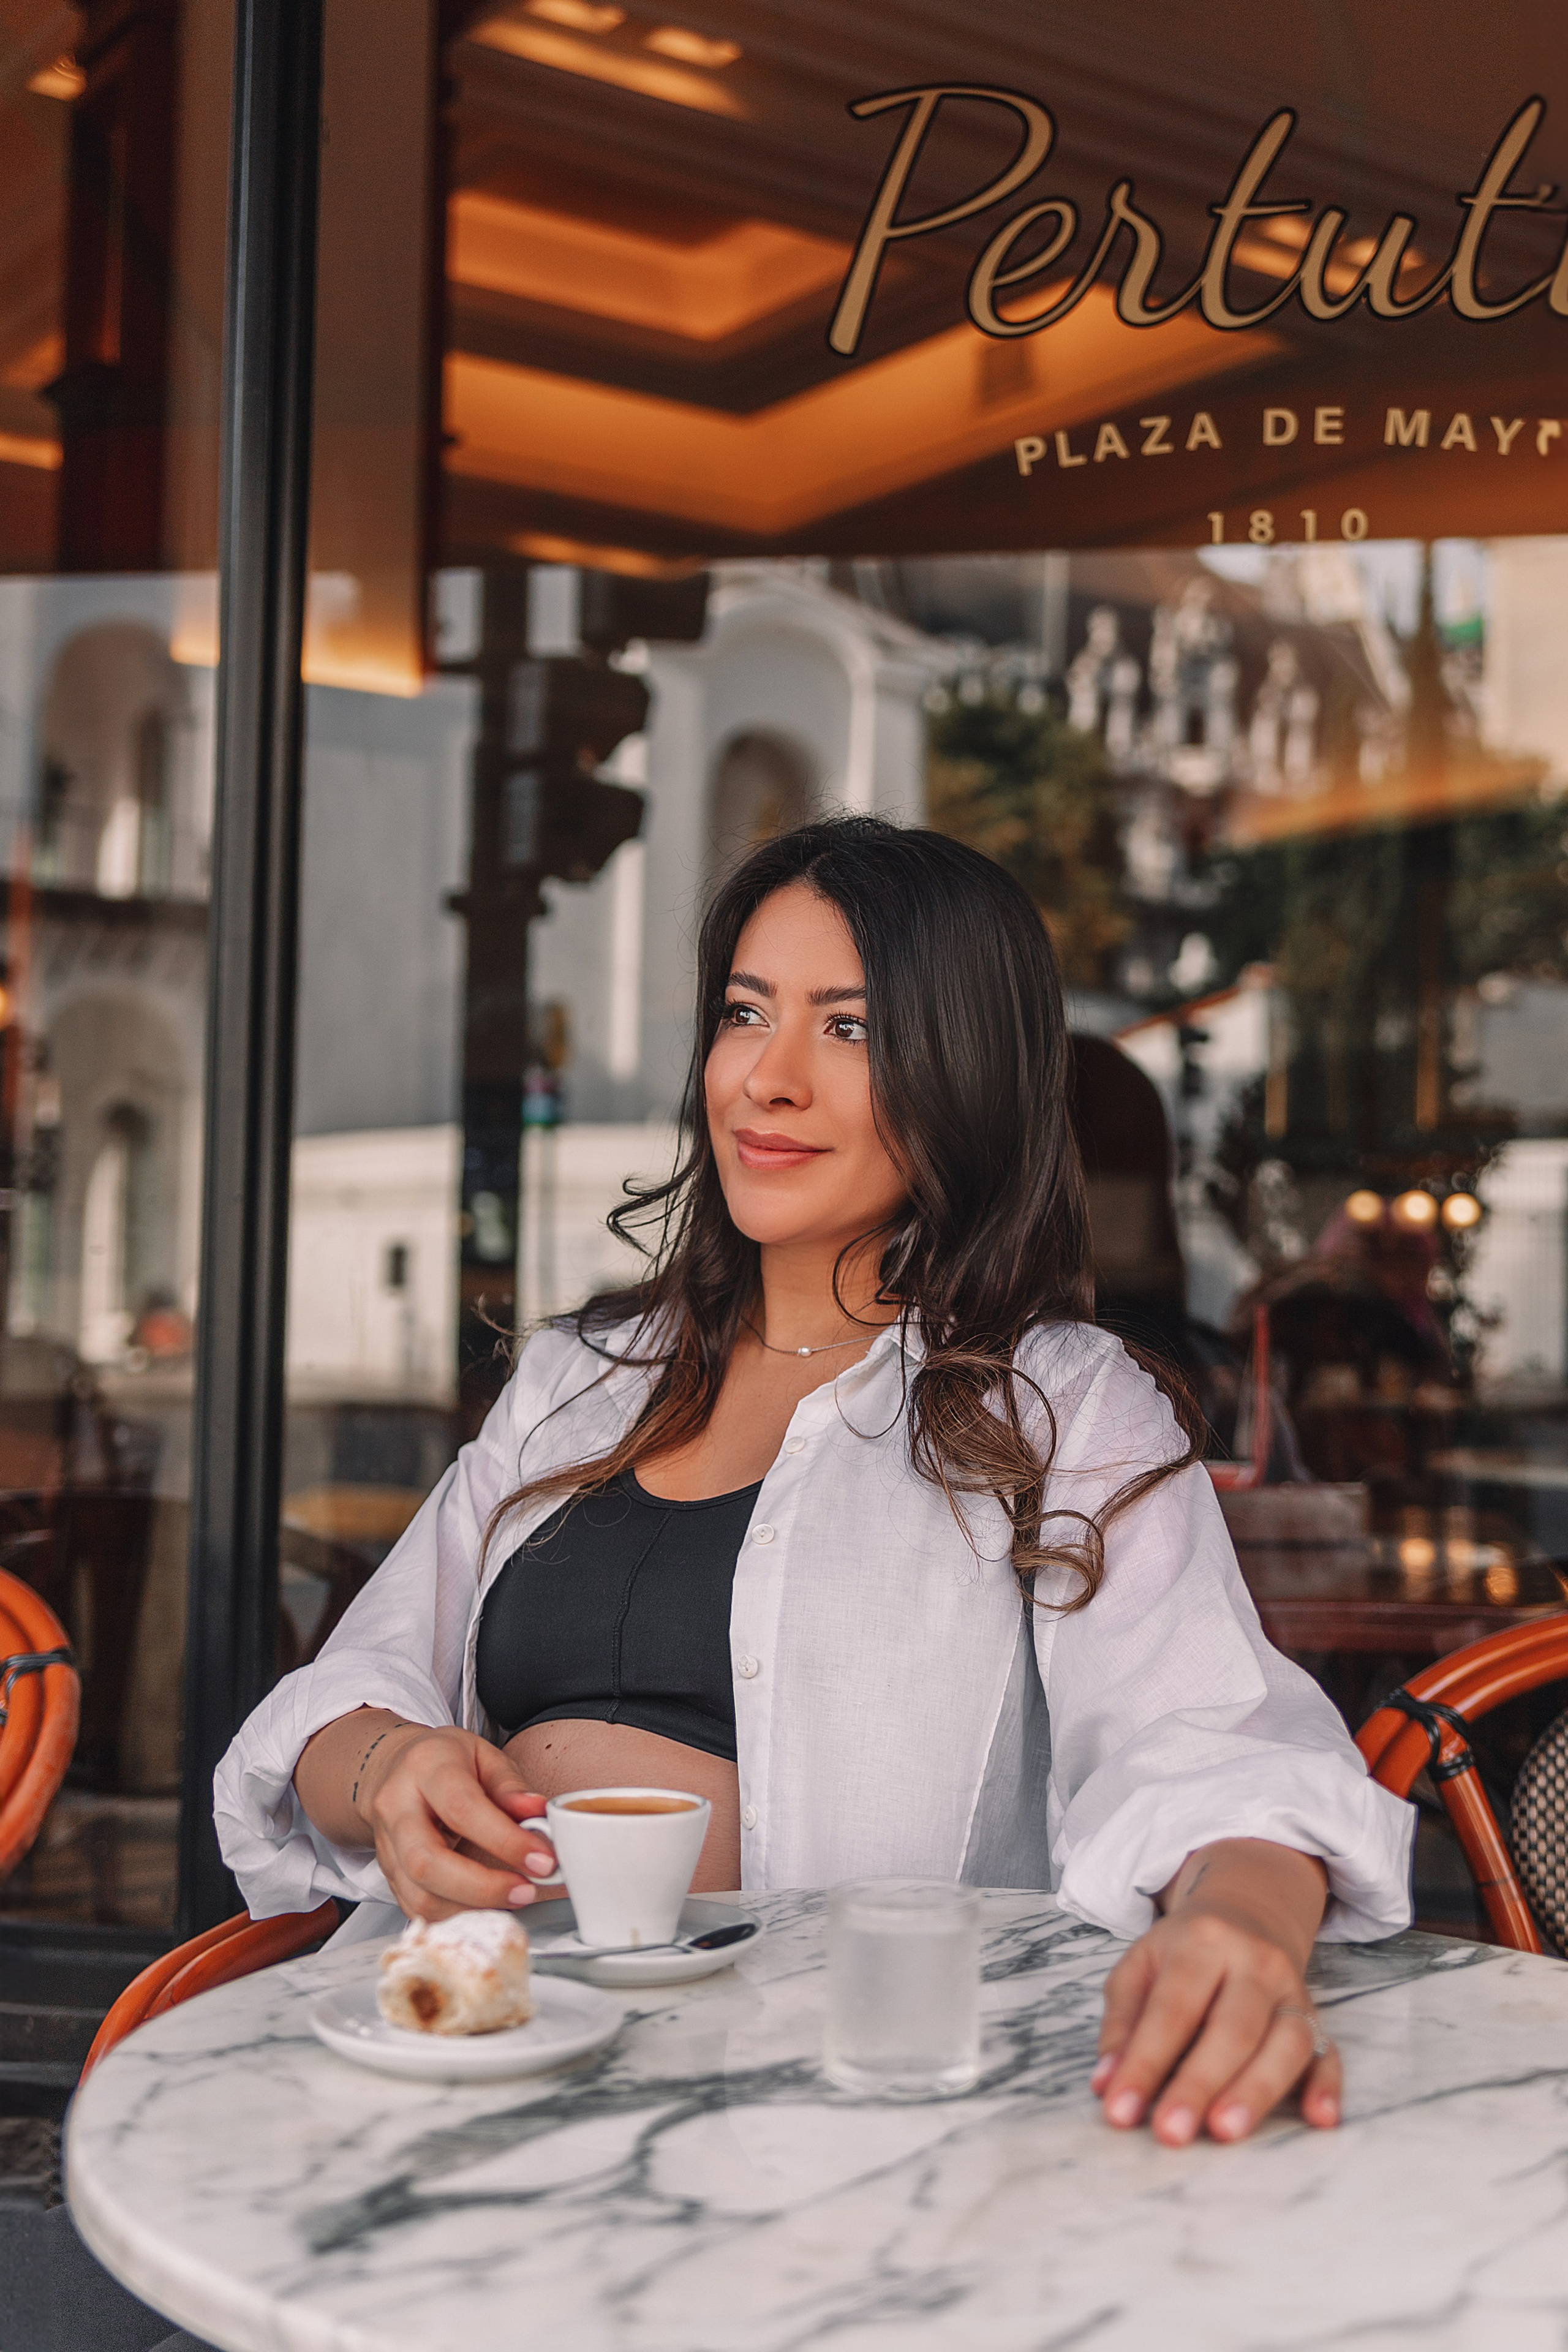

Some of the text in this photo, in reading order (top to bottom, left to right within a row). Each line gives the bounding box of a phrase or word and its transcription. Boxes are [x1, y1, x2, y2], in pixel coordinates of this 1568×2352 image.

[1014, 411, 1224, 477] PLAZA
[1262, 405, 1345, 447] DE
[1207, 508, 1369, 545] 1810
